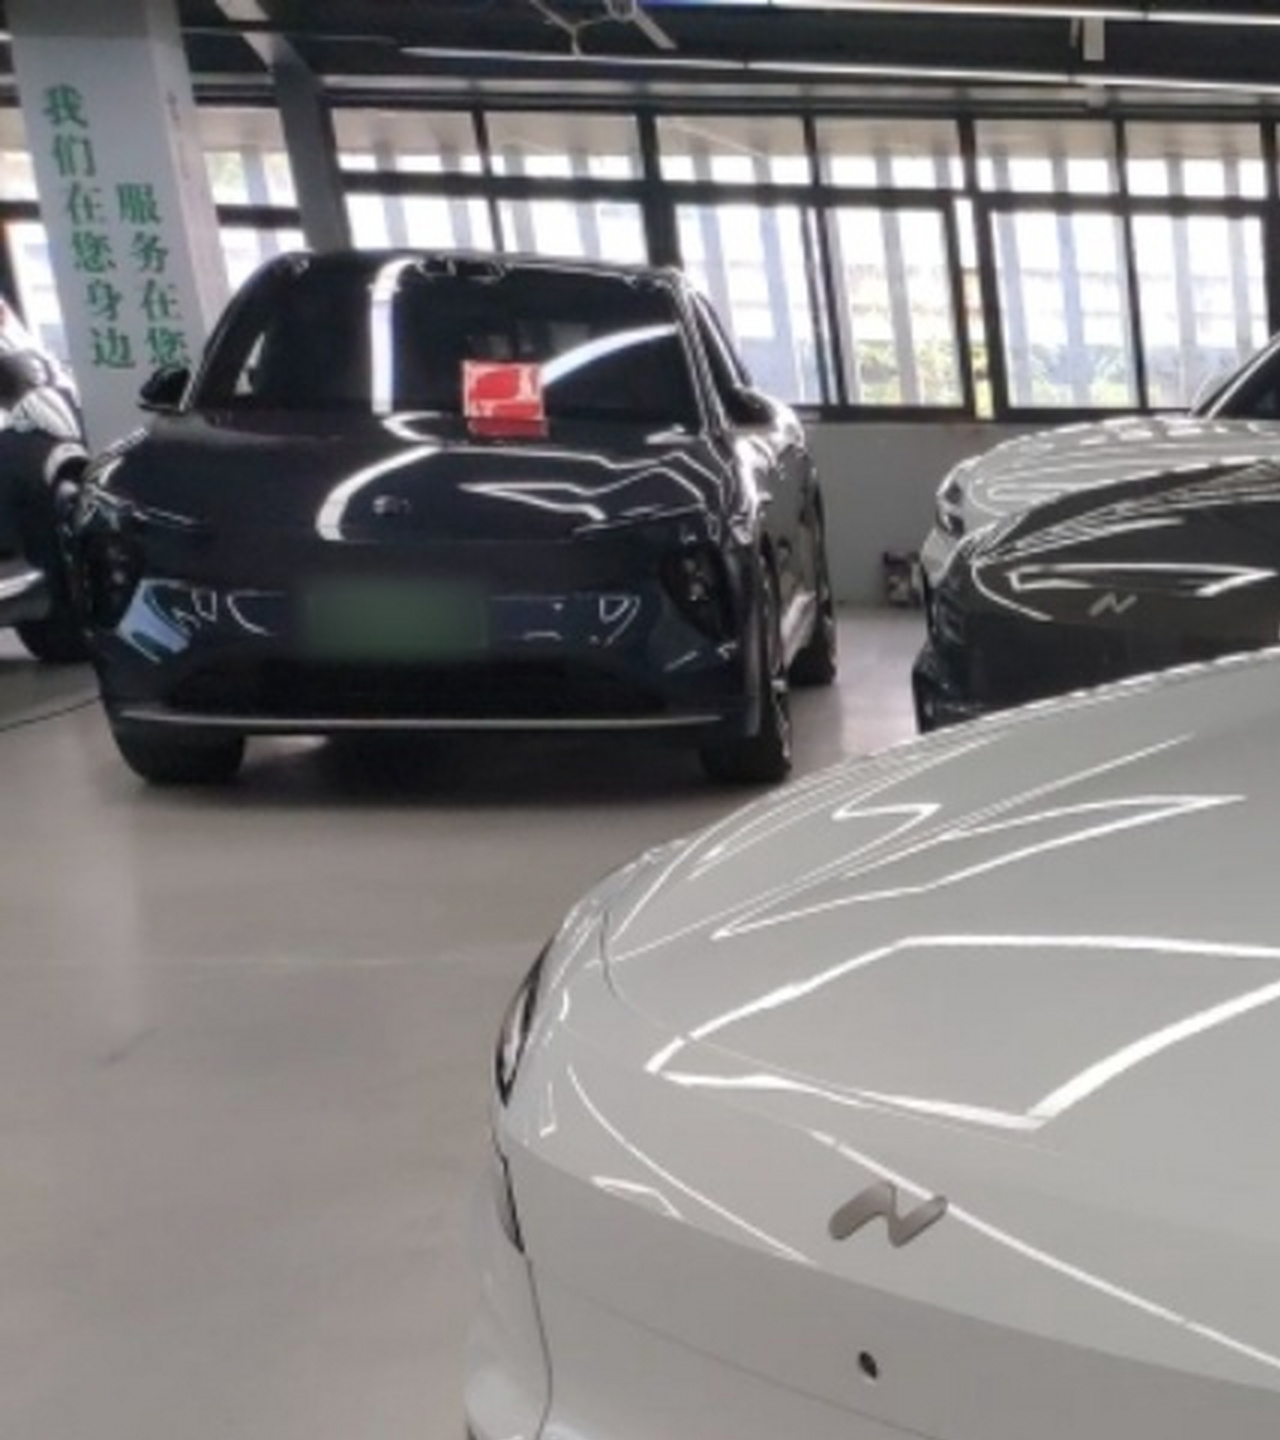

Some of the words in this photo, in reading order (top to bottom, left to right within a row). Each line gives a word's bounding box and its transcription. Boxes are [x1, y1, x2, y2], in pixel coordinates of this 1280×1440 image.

[42, 82, 136, 370] 我们在您身边
